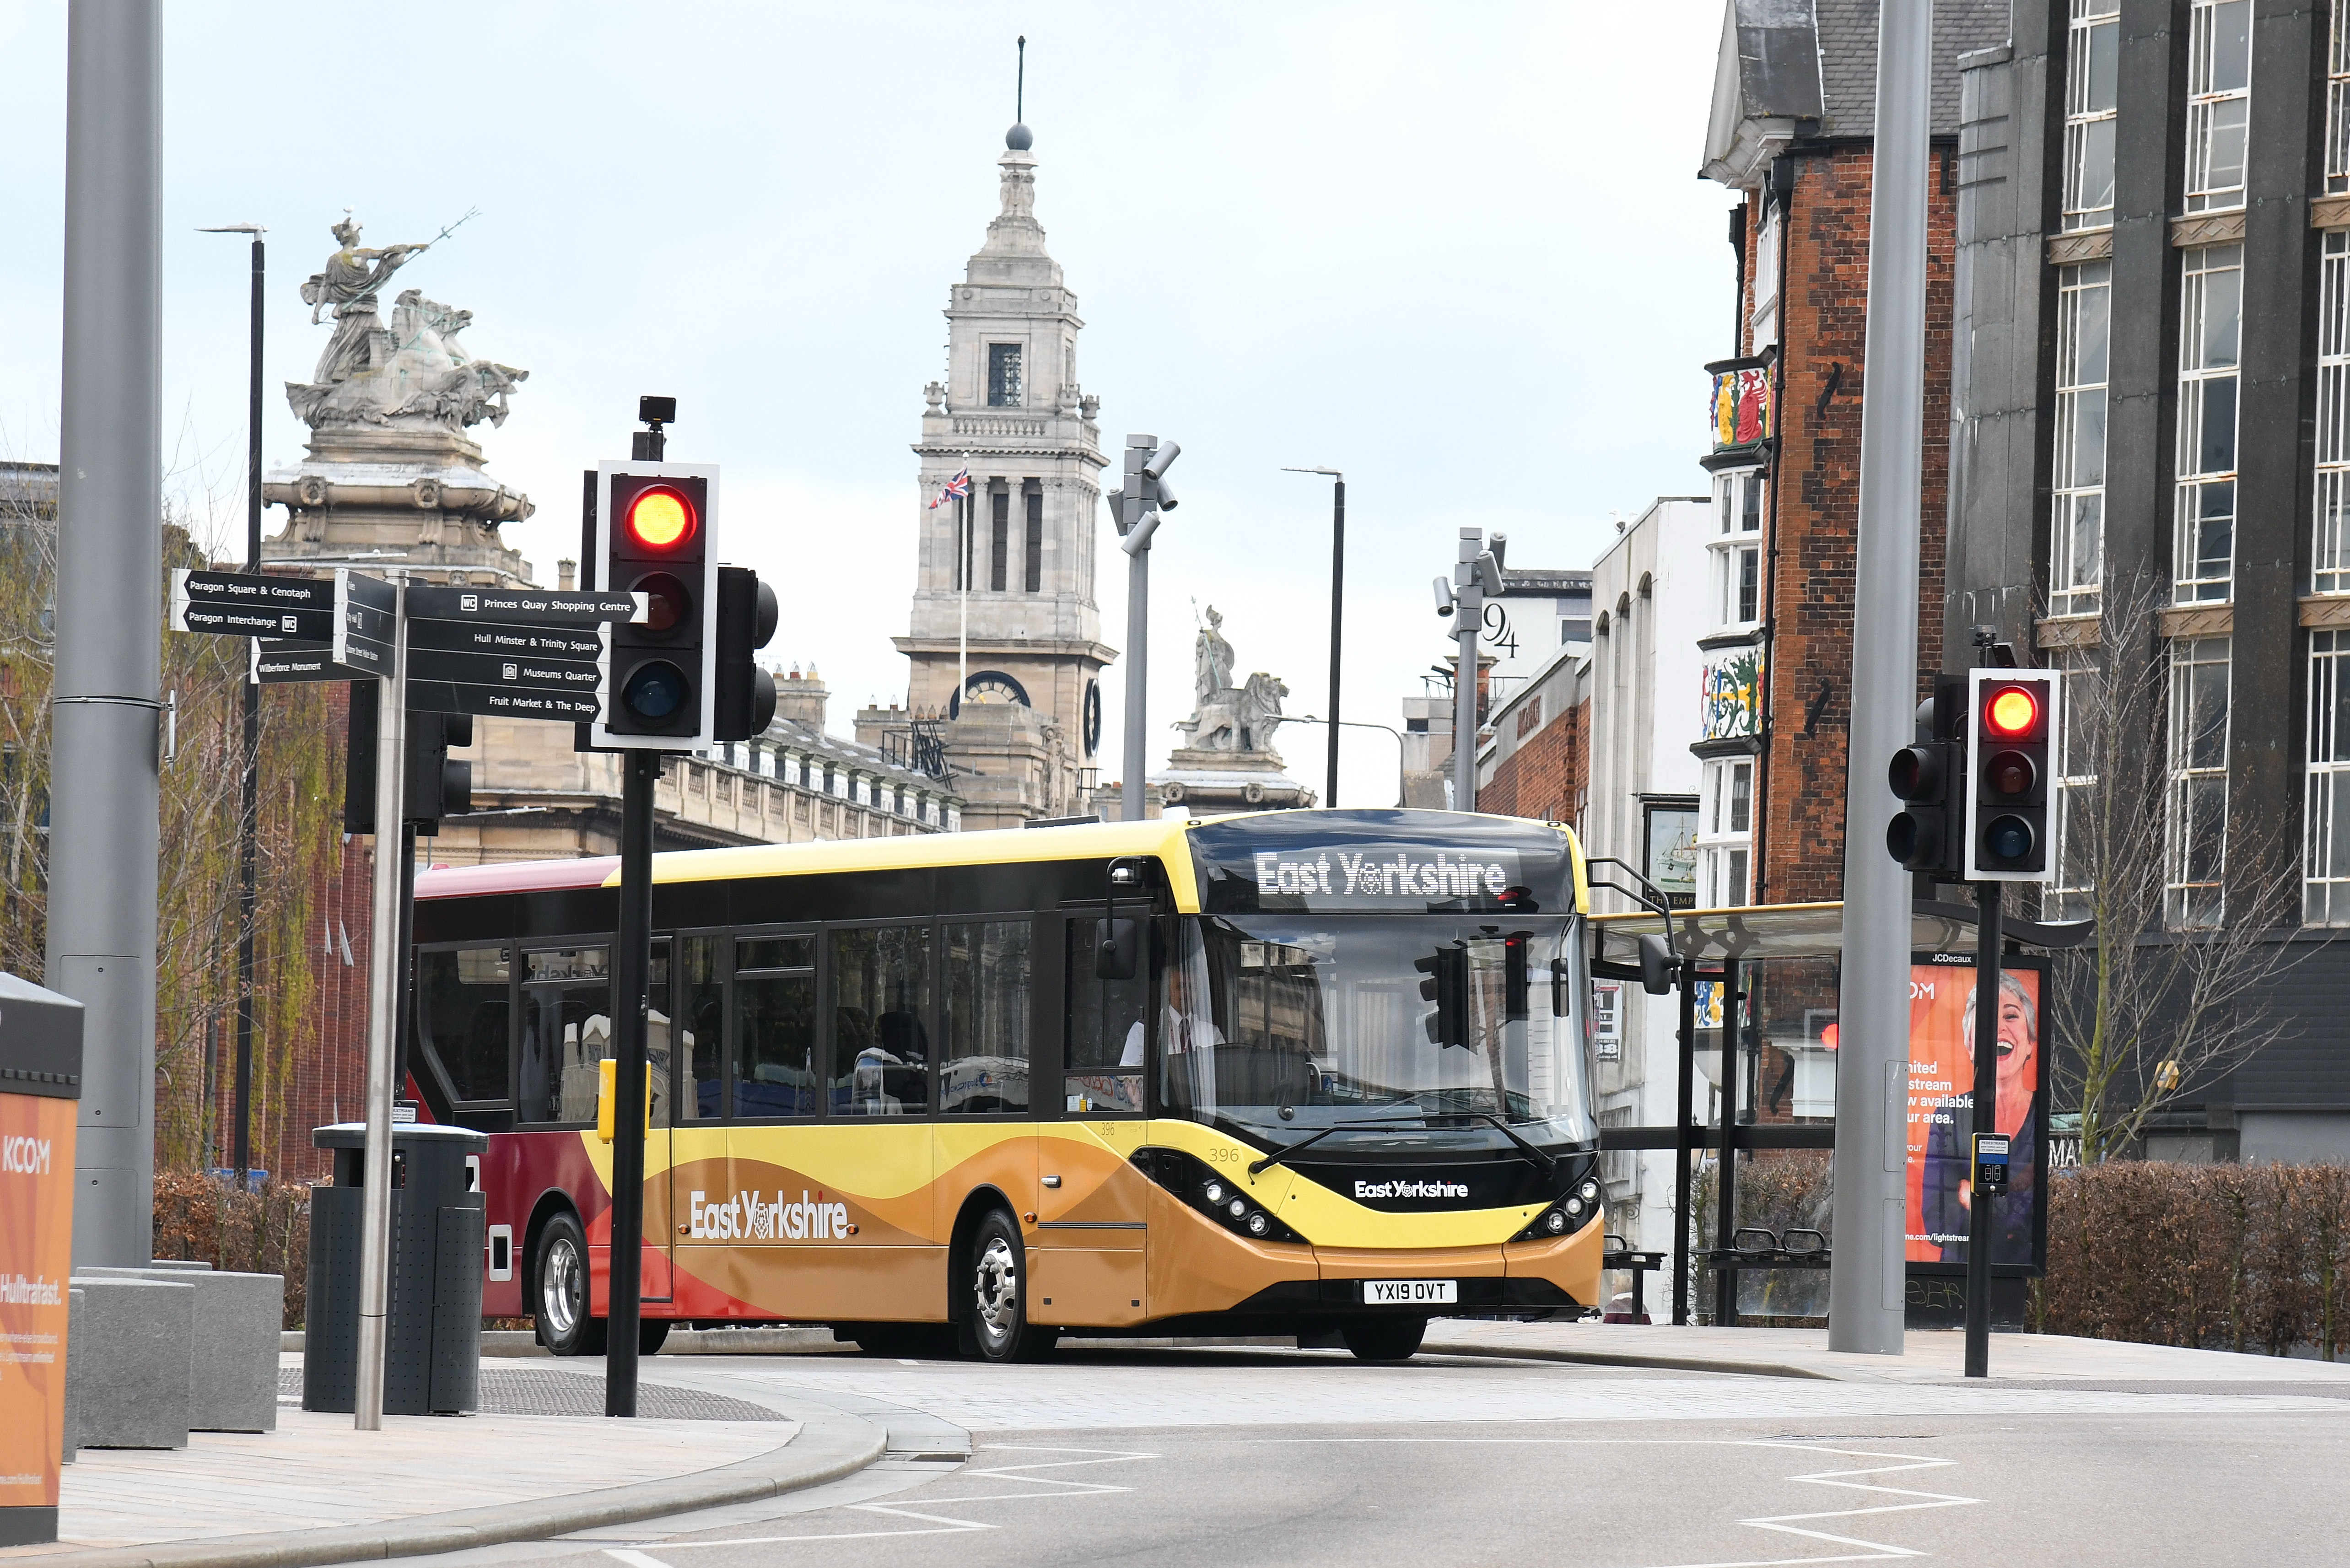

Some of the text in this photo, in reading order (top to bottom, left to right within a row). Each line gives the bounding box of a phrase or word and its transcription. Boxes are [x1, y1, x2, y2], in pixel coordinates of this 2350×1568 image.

[189, 581, 311, 600] Paragon Square & Cenotaph
[463, 598, 631, 612] WC Princes Quay Shopping Centre
[189, 612, 296, 629] Paragon Interchange WC
[1482, 603, 1520, 658] 94
[474, 634, 598, 652] Hull Minster & Trinity Square
[259, 663, 321, 673] Wilberforce Monument
[523, 668, 597, 681] Museums Quarter
[489, 696, 596, 714] Fruit Market & The Deep
[1256, 852, 1507, 895] East Yorkshire
[1649, 895, 1696, 905] TH EMP
[1932, 954, 1972, 963] JCDecaux
[1910, 982, 1935, 999] OM
[1908, 1078, 1952, 1091] stream
[1920, 1094, 1973, 1108] available
[1923, 1114, 1954, 1124] area.
[1101, 1122, 1115, 1136] 396
[2, 1136, 51, 1175] KCOM
[1209, 1148, 1239, 1162] 396
[1355, 1180, 1468, 1197] East Yorkshire
[690, 1190, 847, 1239] East Yorkshire
[1374, 1283, 1445, 1299] YX19 OVT
